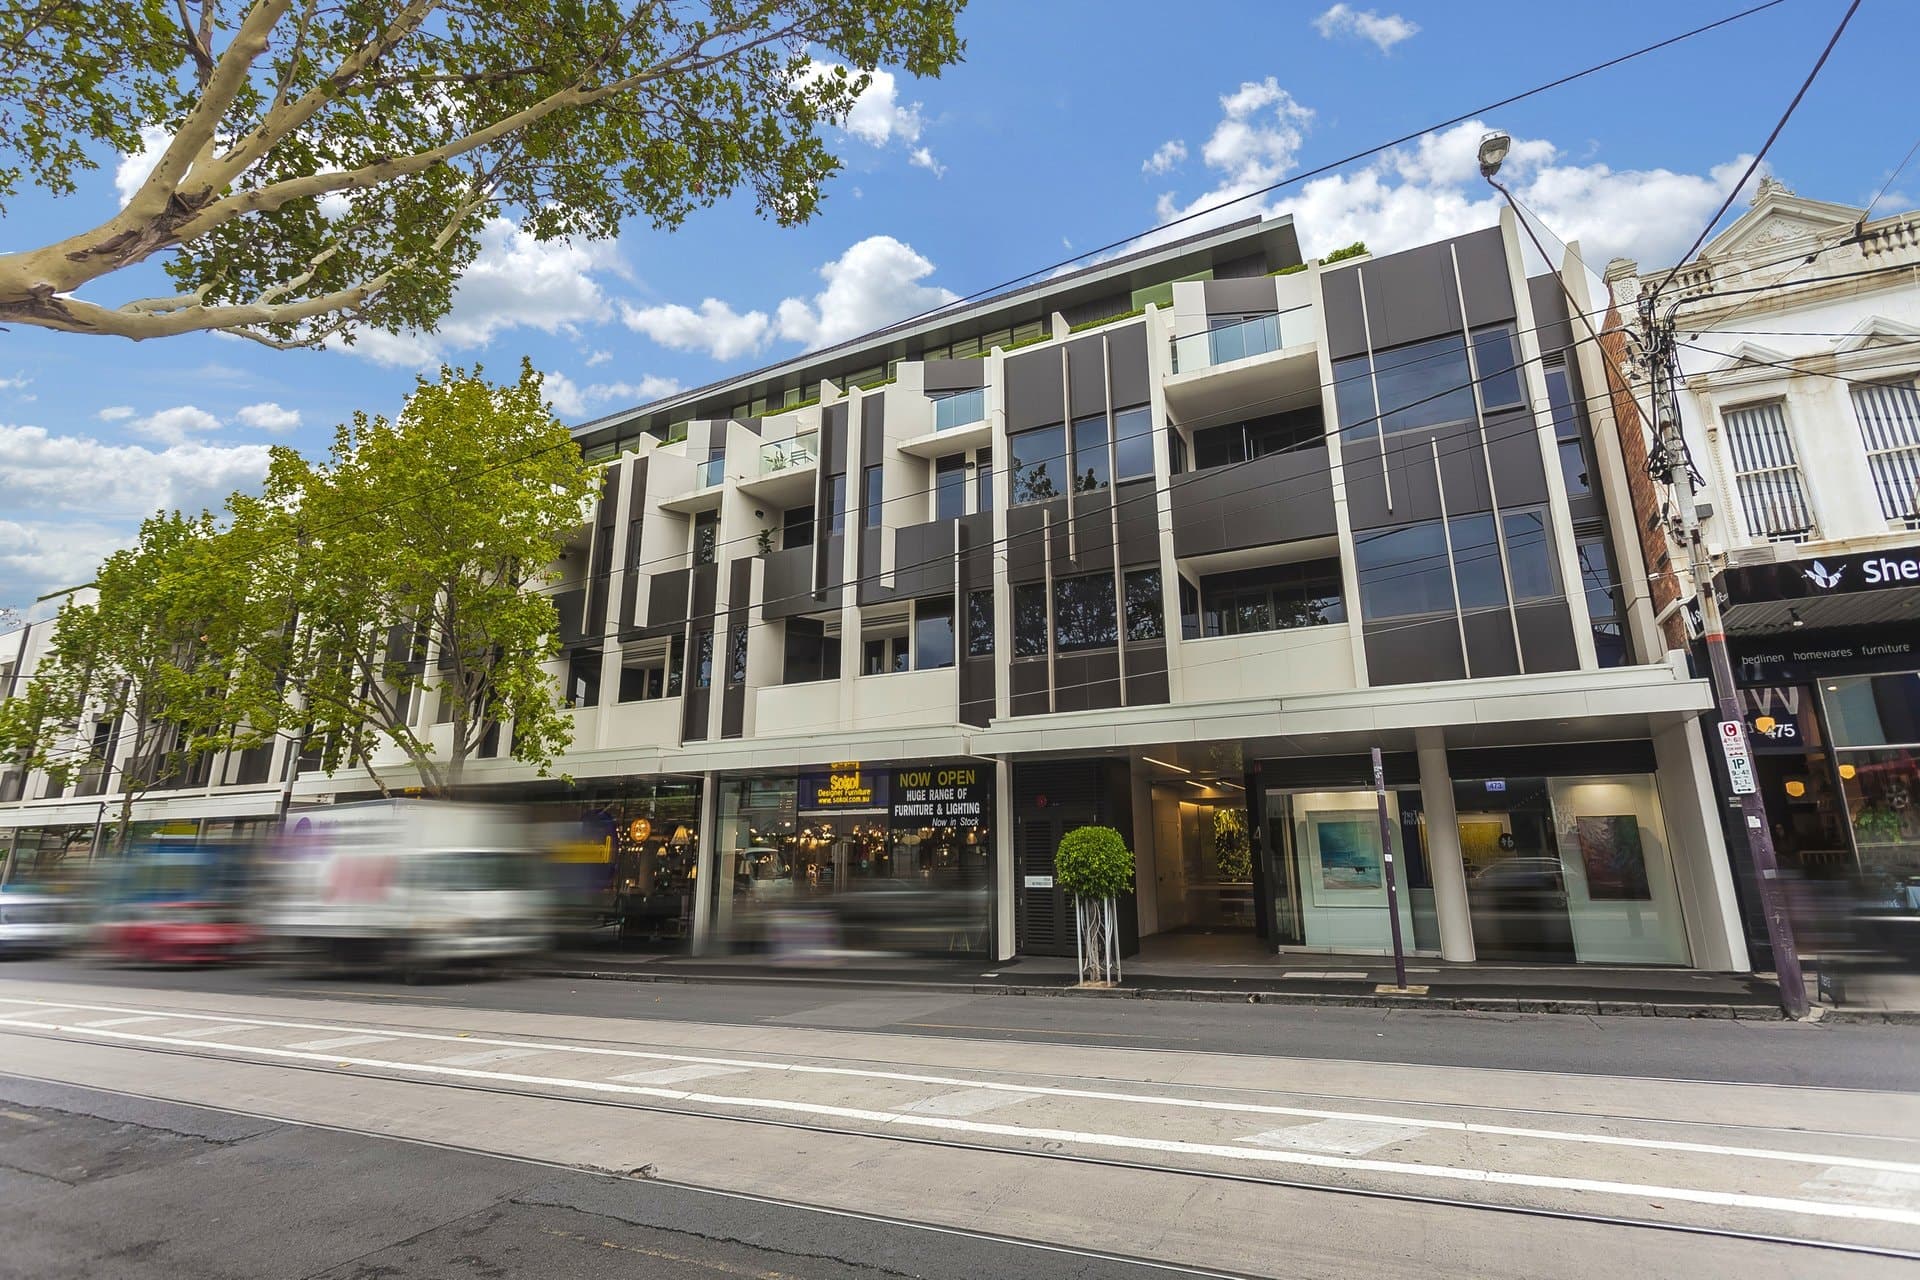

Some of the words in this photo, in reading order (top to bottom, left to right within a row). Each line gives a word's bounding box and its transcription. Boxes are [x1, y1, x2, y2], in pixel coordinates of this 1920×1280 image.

[1863, 558, 1920, 583] She
[1741, 653, 1785, 665] bedlinen
[1793, 648, 1853, 661] homewares
[1861, 643, 1910, 656] furniture
[1724, 724, 1737, 737] C
[1765, 723, 1795, 739] 475
[1732, 759, 1745, 770] 1P
[830, 771, 859, 790] Sokol
[900, 772, 931, 788] NOW
[937, 769, 975, 786] OPEN
[817, 789, 843, 797] Designer
[844, 788, 871, 796] Furniture
[906, 789, 926, 802] HUGE
[929, 788, 954, 801] RANGE
[957, 788, 967, 800] OF
[894, 803, 934, 817] FURNITURE
[936, 803, 943, 815] &
[946, 802, 980, 815] LIGHTING
[932, 817, 948, 827] Now
[950, 817, 957, 826] in
[960, 816, 979, 826] Stock
